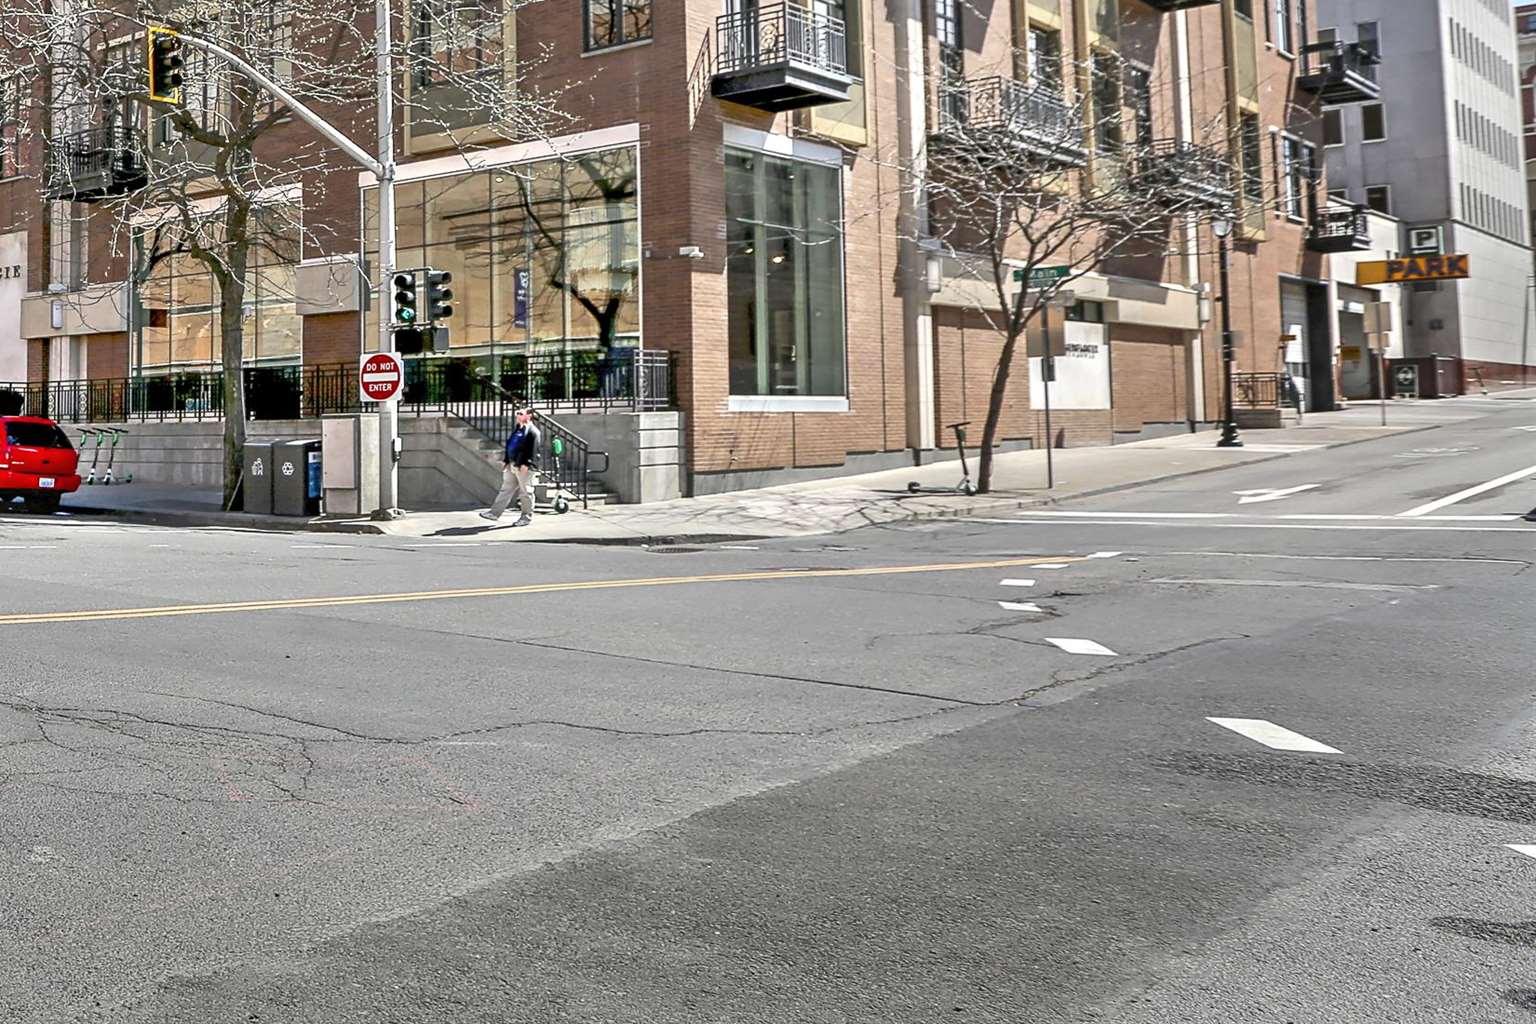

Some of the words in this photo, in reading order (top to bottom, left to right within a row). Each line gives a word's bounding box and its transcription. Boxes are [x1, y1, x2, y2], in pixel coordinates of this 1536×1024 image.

[1386, 255, 1468, 278] PARK
[366, 363, 377, 371] DO
[379, 362, 395, 371] NOT
[368, 383, 393, 392] ENTER
